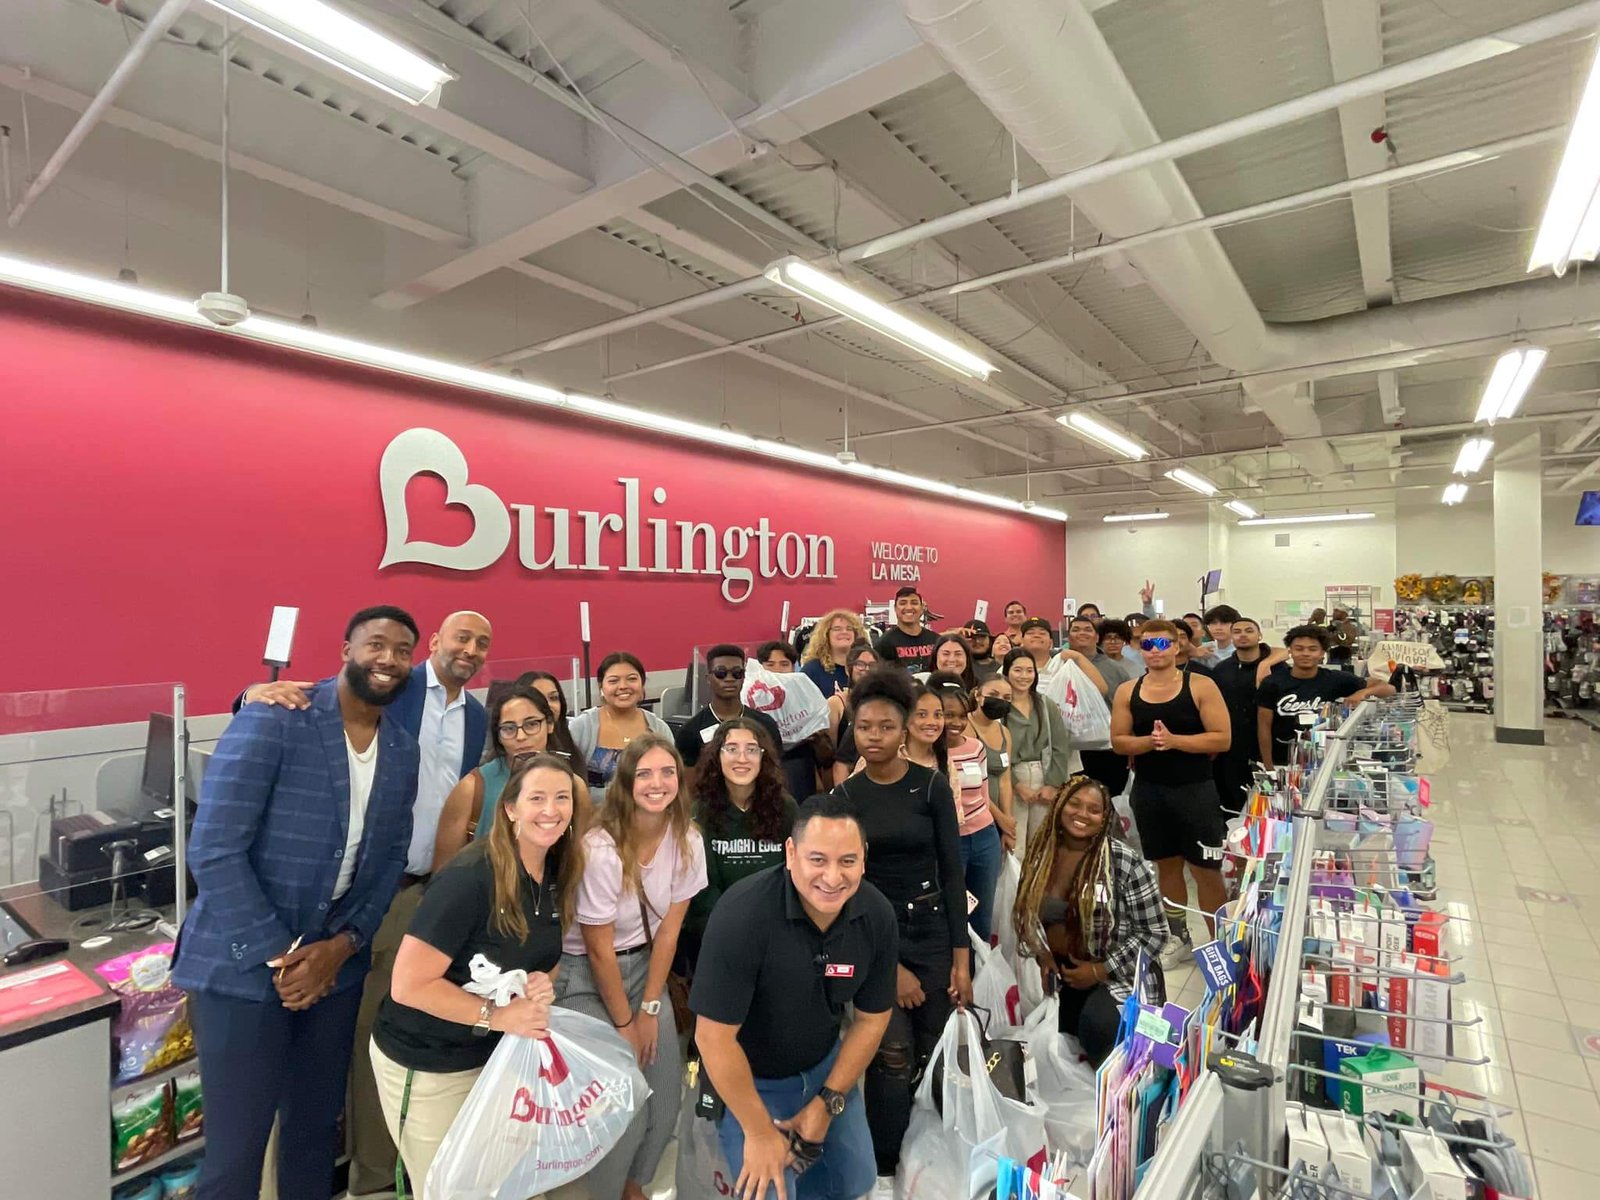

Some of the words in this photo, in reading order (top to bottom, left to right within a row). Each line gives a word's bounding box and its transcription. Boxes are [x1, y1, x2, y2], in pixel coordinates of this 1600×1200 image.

[379, 427, 838, 604] Burlington
[871, 541, 924, 563] WELCOME
[925, 546, 938, 564] TO
[872, 562, 888, 581] LA
[890, 563, 921, 582] MESA
[711, 838, 756, 855] STRAIGHT
[1205, 946, 1219, 963] GIFT
[1213, 964, 1230, 986] BAGS
[1335, 1042, 1358, 1056] TEK
